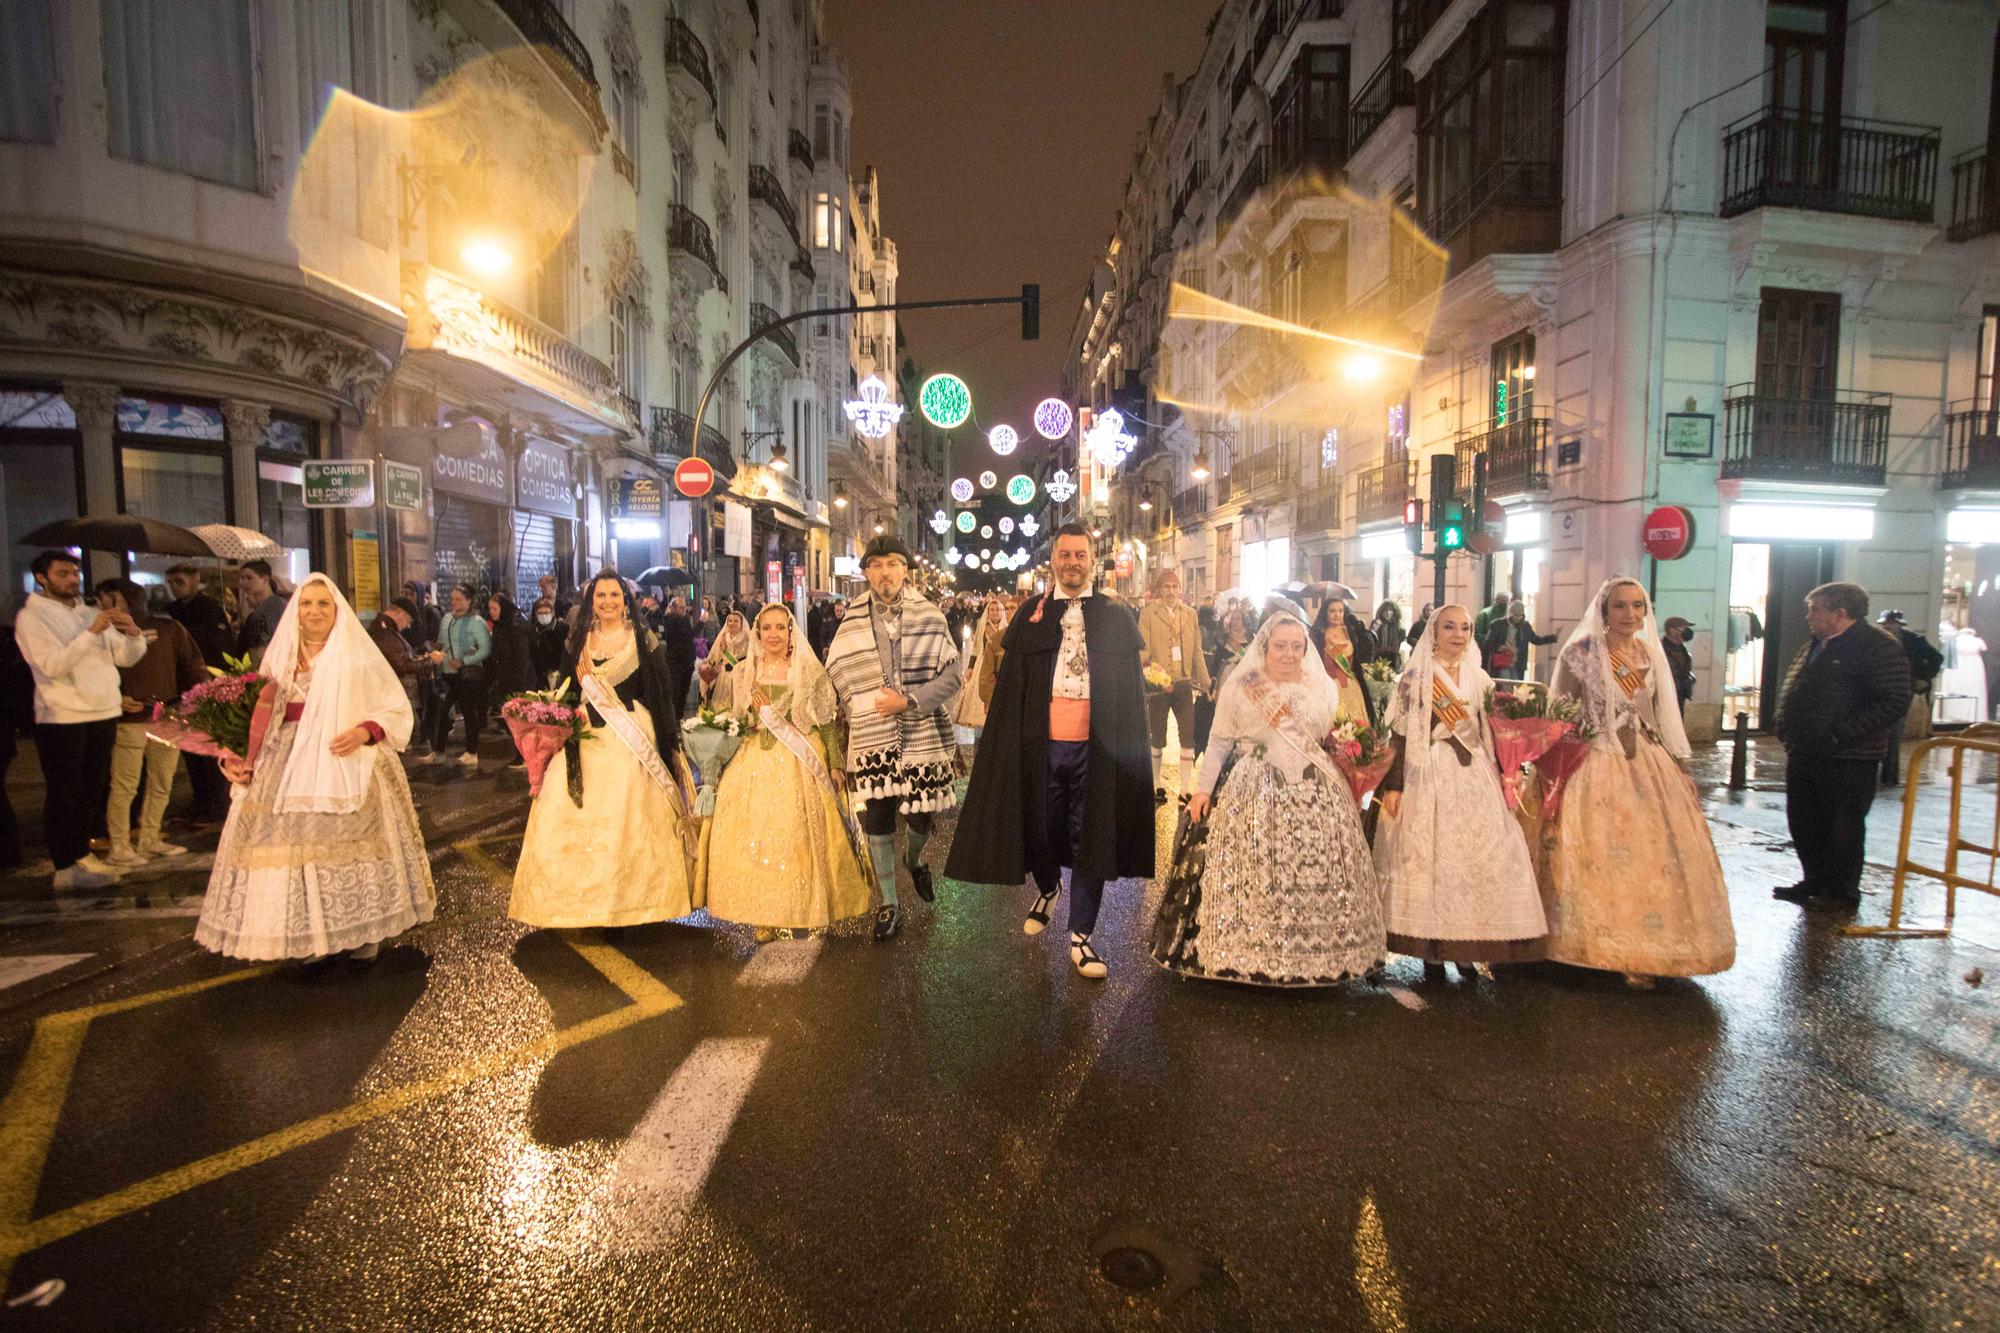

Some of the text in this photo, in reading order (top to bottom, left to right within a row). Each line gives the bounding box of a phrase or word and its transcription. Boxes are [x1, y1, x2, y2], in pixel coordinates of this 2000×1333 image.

[322, 466, 365, 475] CARRER
[436, 454, 505, 488] COMEDIAS
[331, 478, 343, 486] DE
[520, 477, 571, 504] COMEDIAS
[307, 488, 323, 497] LES
[609, 480, 622, 518] ORO
